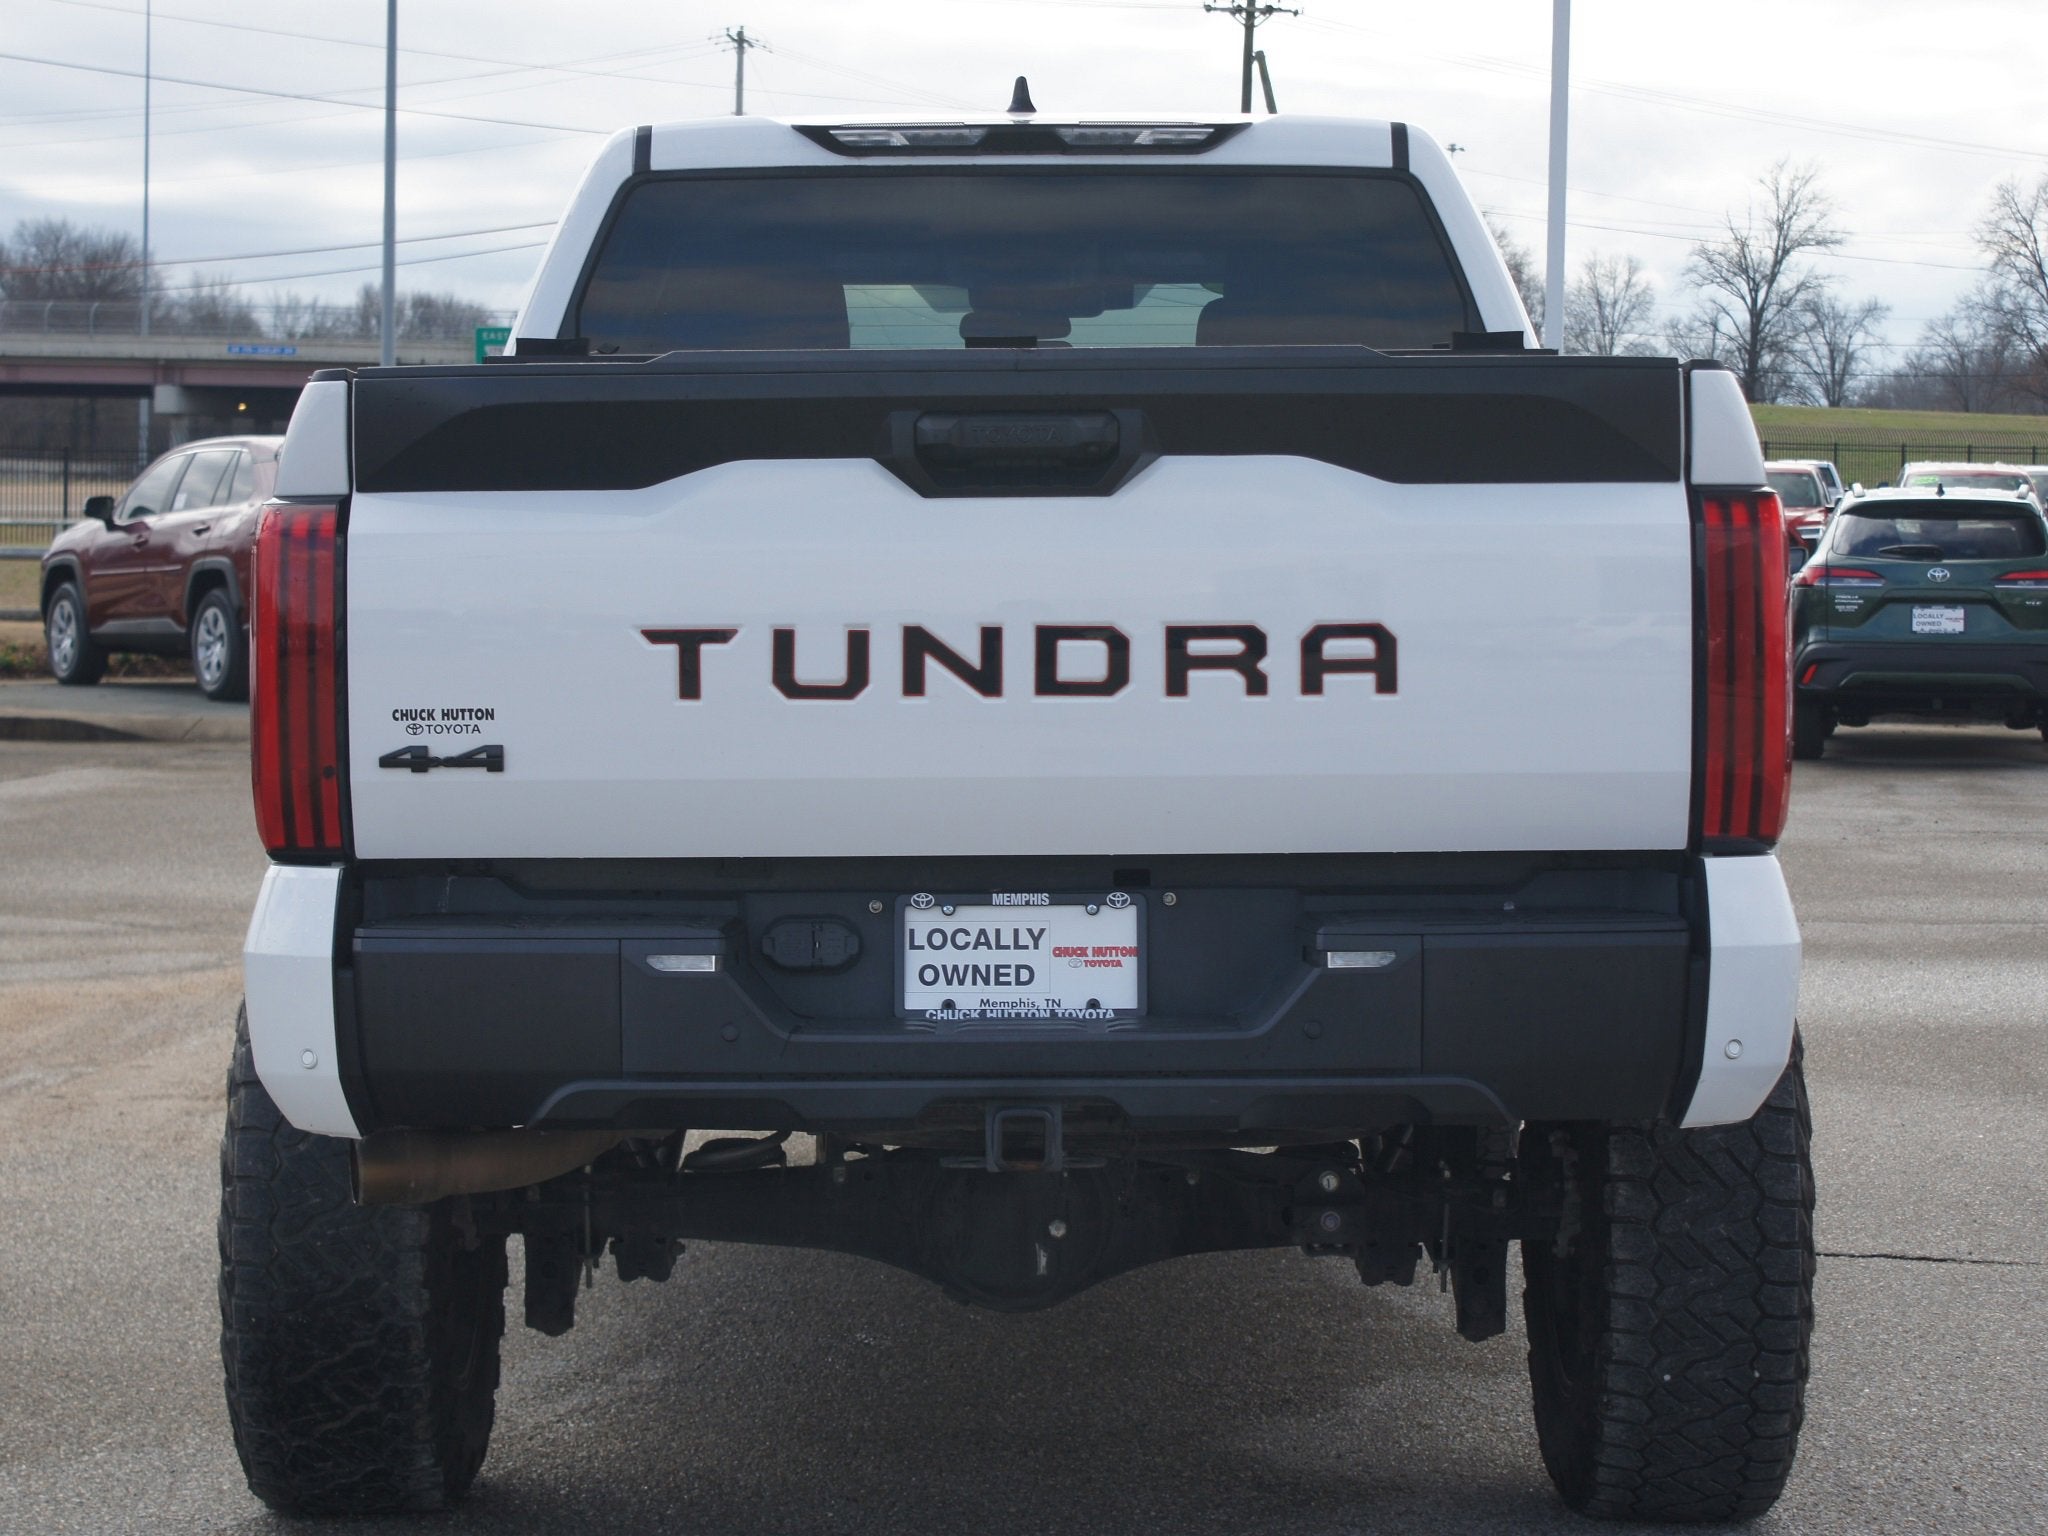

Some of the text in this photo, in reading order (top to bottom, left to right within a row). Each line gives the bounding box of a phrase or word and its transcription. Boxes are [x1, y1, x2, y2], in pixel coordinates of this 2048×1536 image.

[640, 623, 1398, 700] TUNDRA
[392, 708, 495, 721] CHUCK HUTTON
[425, 724, 481, 734] TOYOTA
[992, 893, 1049, 906] MEMPHIS
[908, 928, 1047, 950] LOCALLY
[1052, 946, 1138, 958] CHUCK HUTTON
[1083, 959, 1123, 968] TOYOTA
[918, 964, 1035, 986] OWNED
[979, 998, 1062, 1009] Memphis, TN
